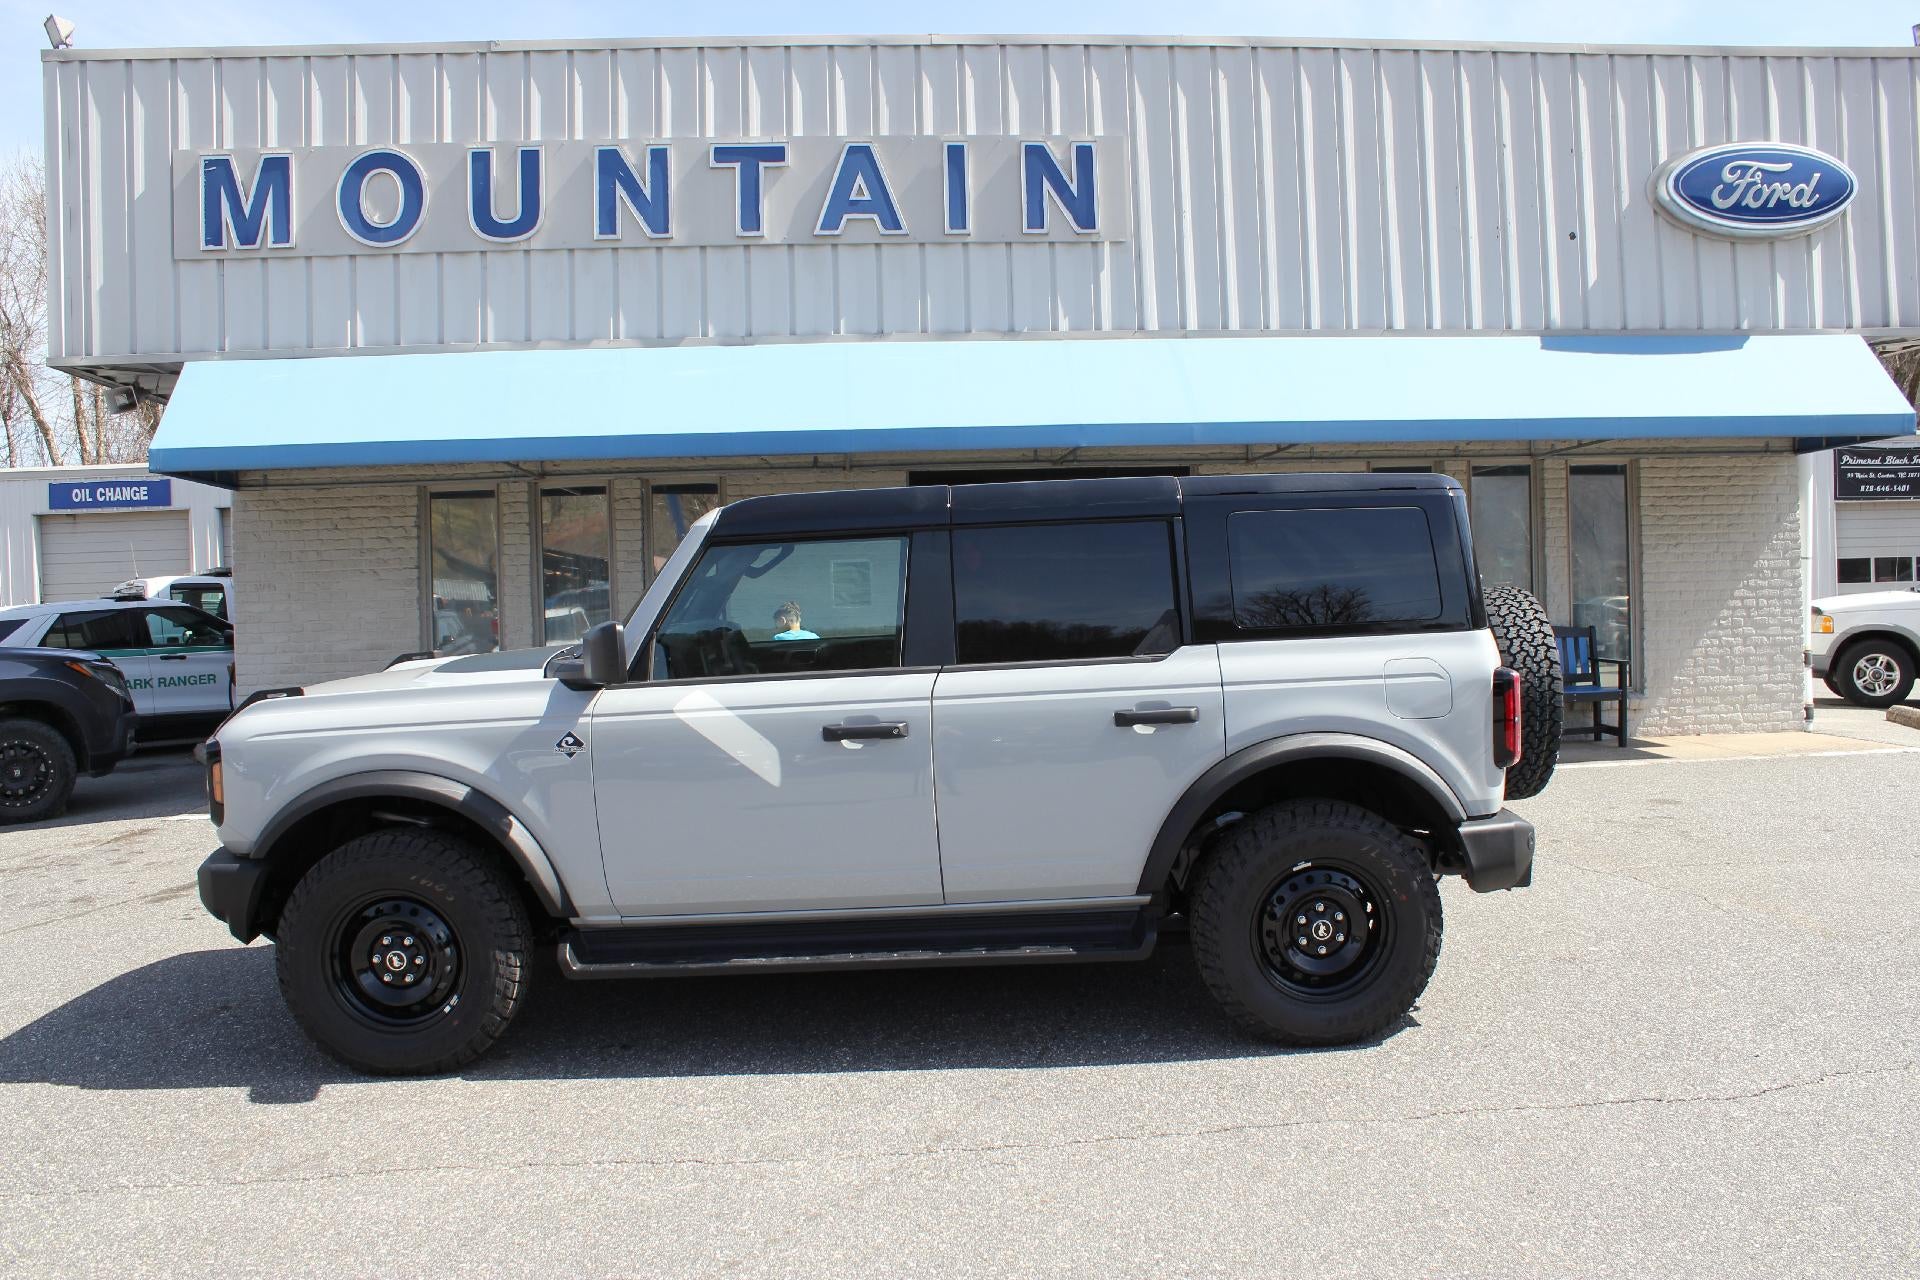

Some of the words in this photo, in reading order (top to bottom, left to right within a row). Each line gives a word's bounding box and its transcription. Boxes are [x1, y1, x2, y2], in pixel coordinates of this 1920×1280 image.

[1711, 160, 1821, 209] Ford
[200, 140, 1099, 251] MOUNTAIN
[1883, 455, 1909, 465] Black
[72, 488, 93, 502] OIL
[96, 486, 149, 502] CHANGE
[123, 678, 154, 690] ARK
[157, 673, 217, 688] RANGER
